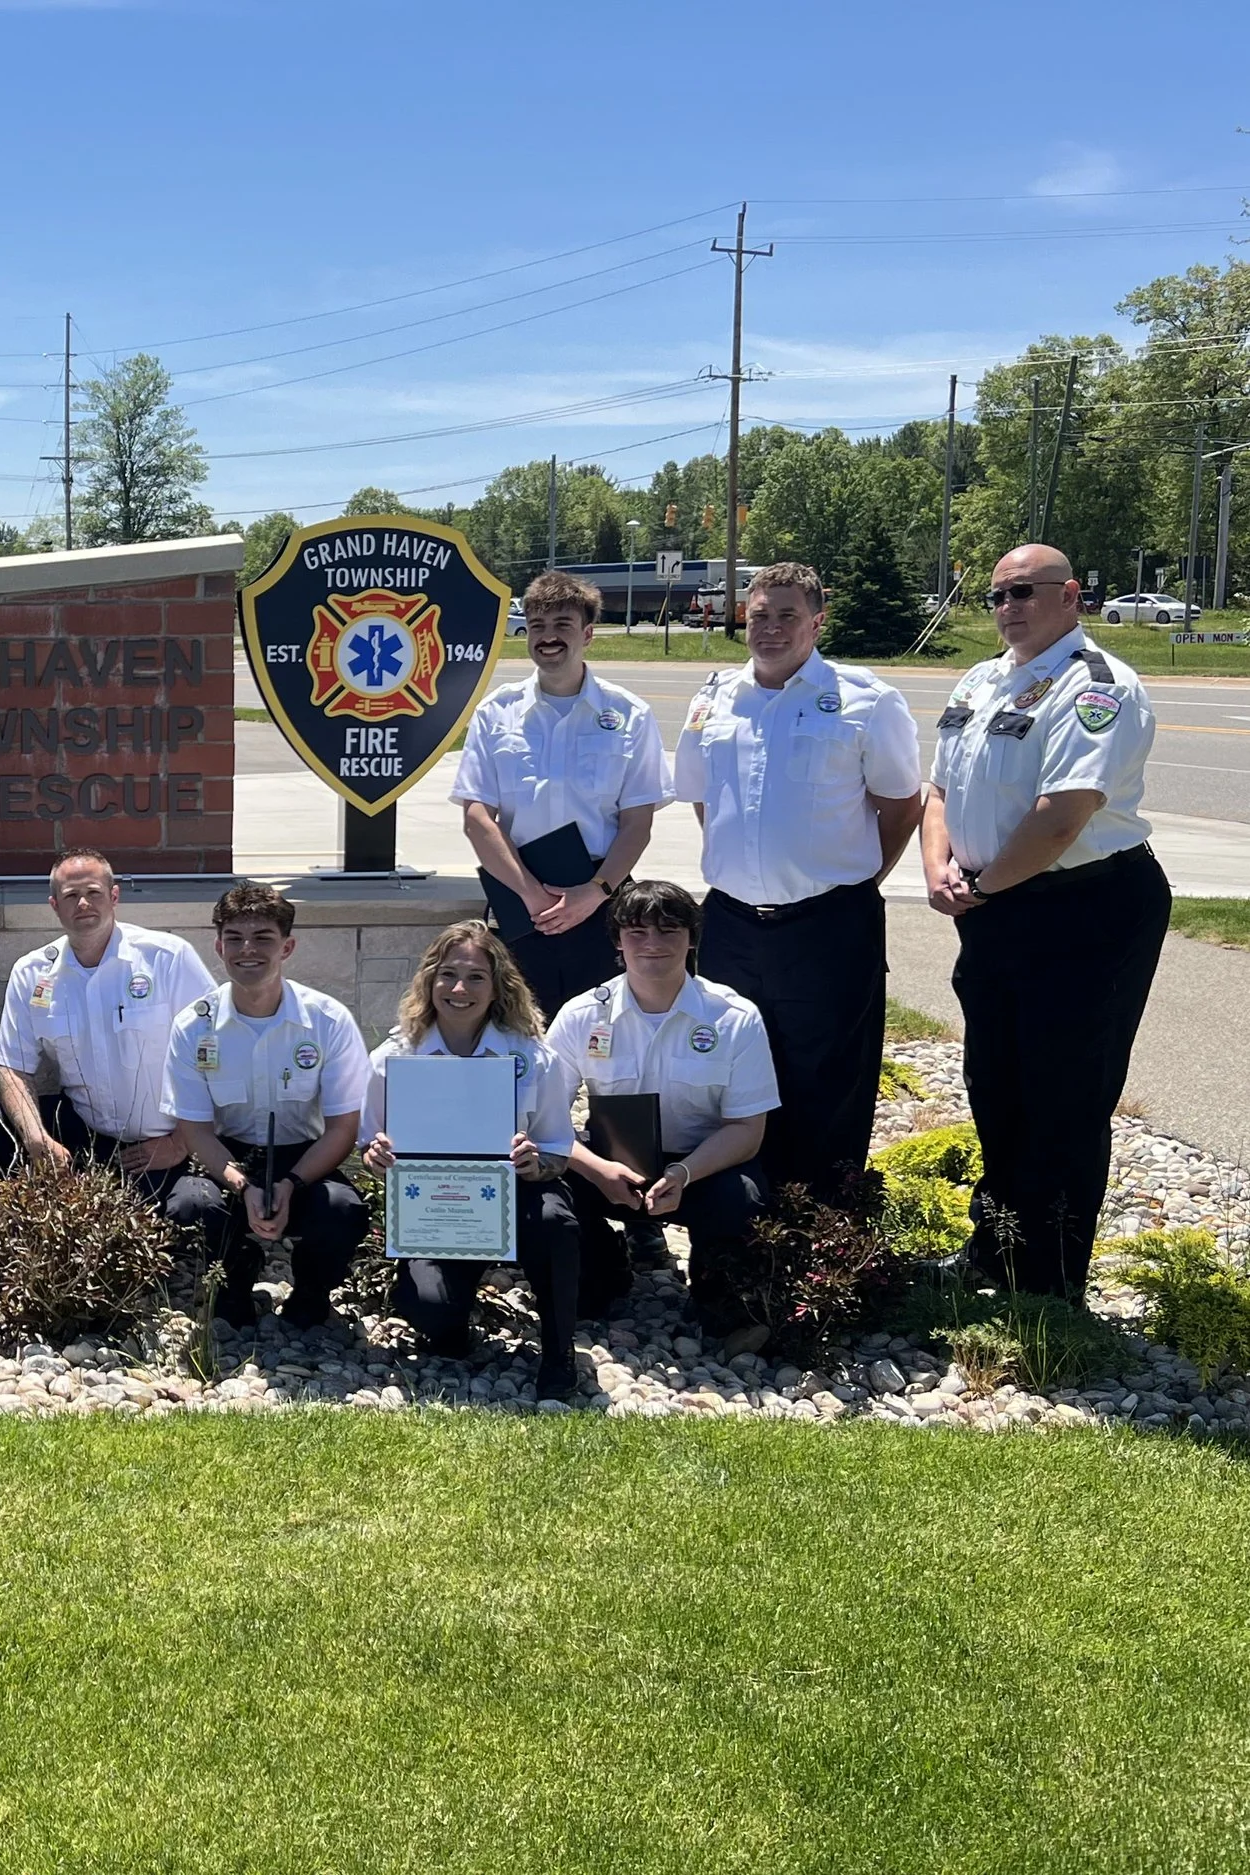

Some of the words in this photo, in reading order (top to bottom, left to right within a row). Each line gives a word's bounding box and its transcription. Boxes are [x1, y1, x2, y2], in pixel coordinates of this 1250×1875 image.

[303, 533, 376, 570] GRAND
[383, 533, 451, 570] HAVEN
[324, 567, 430, 588] TOWNSHIP
[1175, 634, 1205, 644] OPEN
[266, 645, 303, 663] EST.
[446, 644, 484, 662] 1946
[345, 727, 399, 754] FIRE
[340, 757, 402, 777] RESCUE
[453, 1174, 492, 1182] Completion
